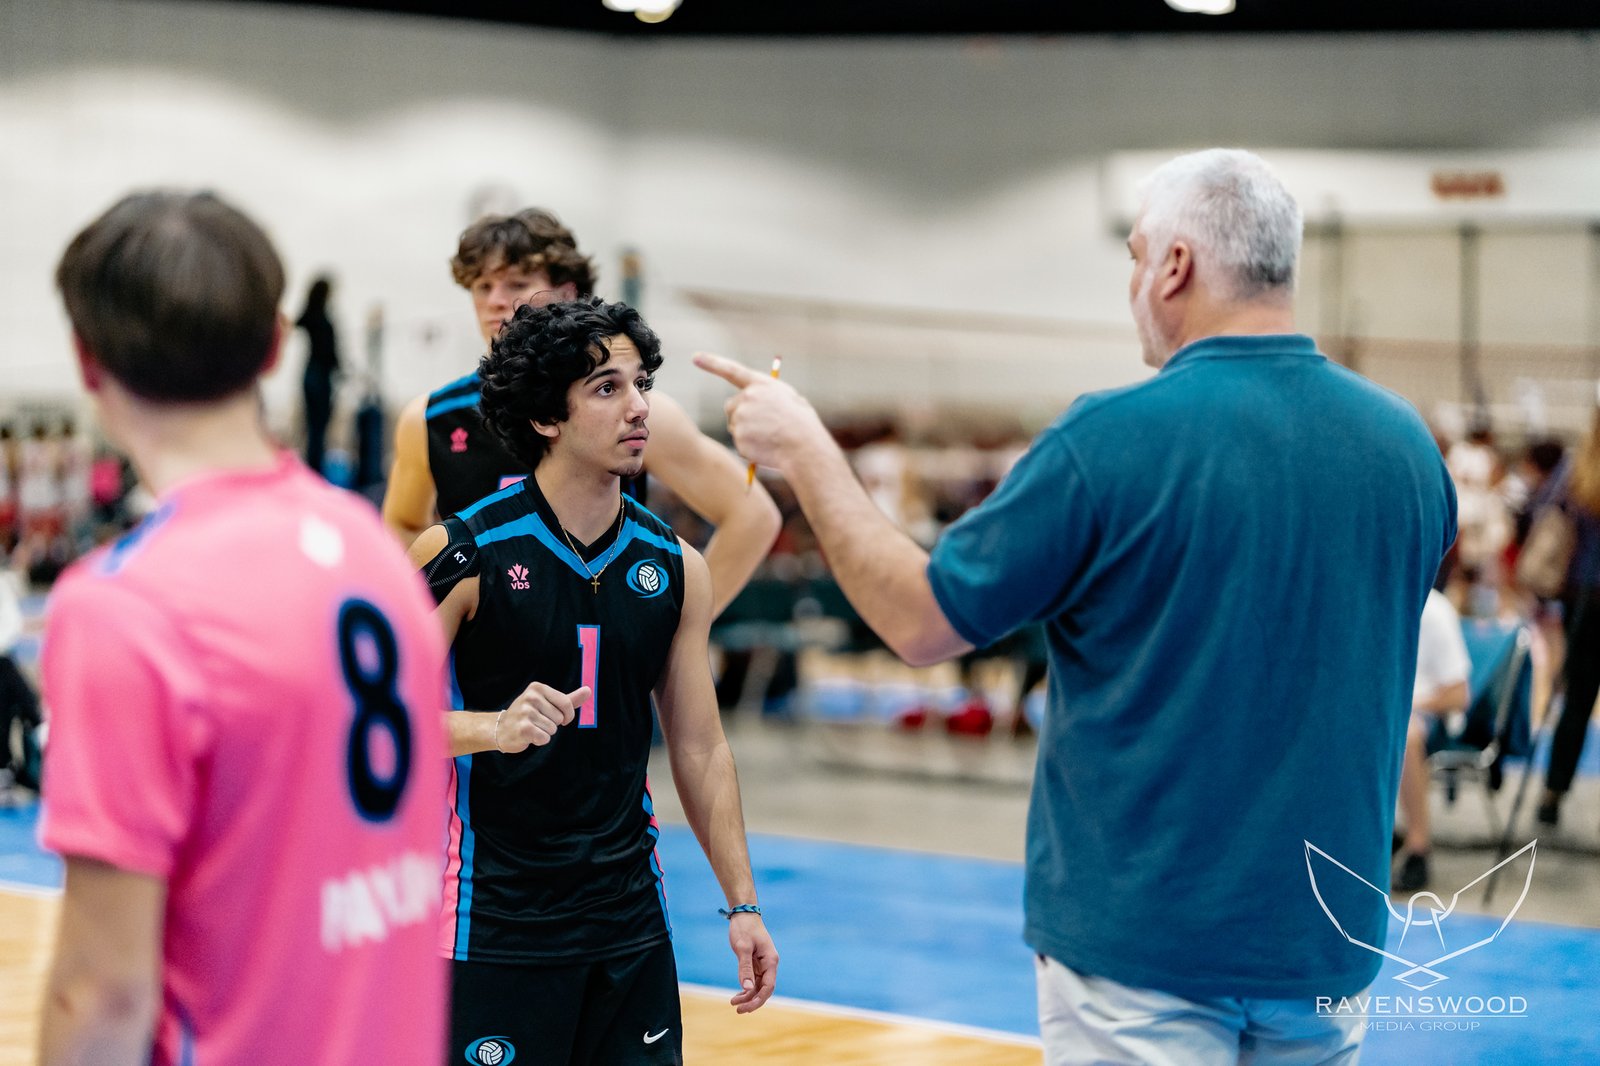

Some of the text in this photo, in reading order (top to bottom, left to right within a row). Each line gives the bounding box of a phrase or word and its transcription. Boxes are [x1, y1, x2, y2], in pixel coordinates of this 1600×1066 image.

[453, 551, 468, 564] KT
[510, 580, 531, 590] vbs
[576, 624, 600, 729] 1
[337, 596, 413, 824] 8
